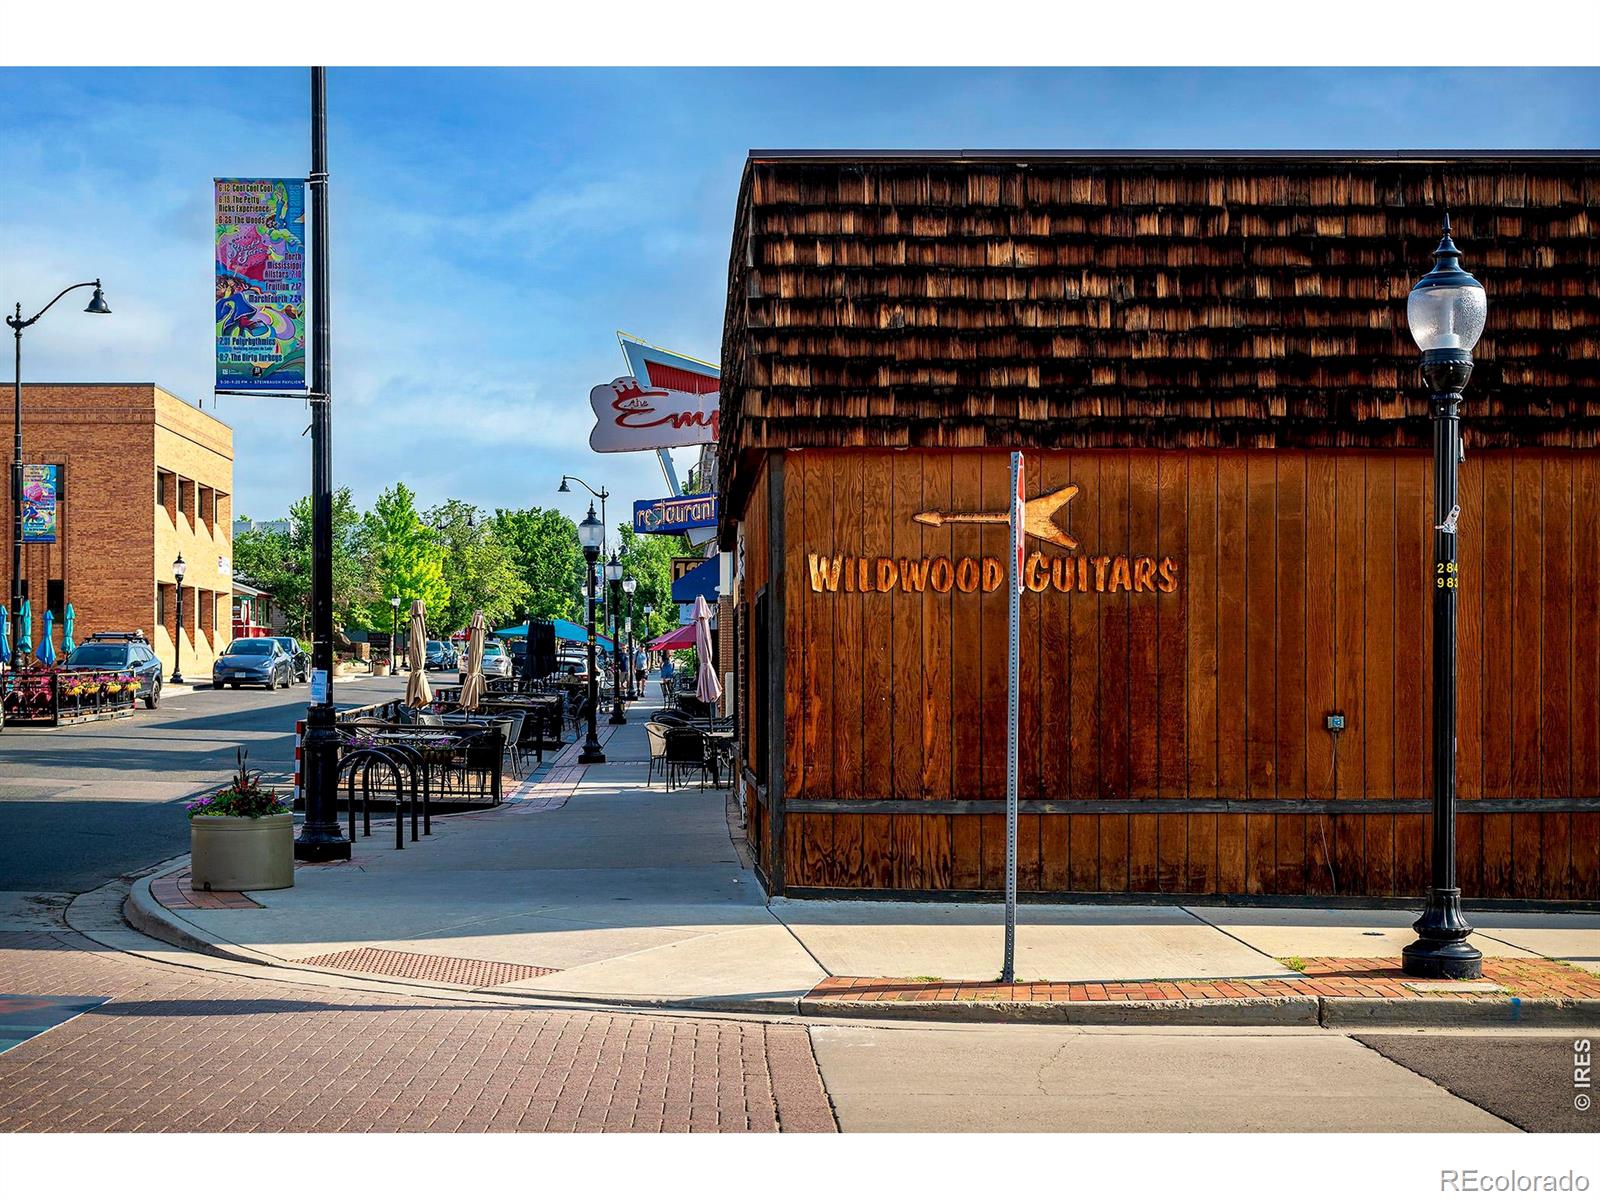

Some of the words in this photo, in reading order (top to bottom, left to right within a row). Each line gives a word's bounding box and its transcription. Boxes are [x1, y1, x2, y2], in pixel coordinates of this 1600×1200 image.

[232, 184, 245, 192] Cool
[246, 184, 259, 192] Cool
[260, 184, 273, 192] Cool
[232, 195, 243, 204] The
[244, 195, 260, 206] Petty
[236, 204, 270, 214] Experience
[234, 215, 245, 224] The
[245, 215, 265, 224] Woods
[284, 252, 302, 261] North
[267, 261, 302, 271] Mississippi
[264, 270, 289, 279] Allstars
[265, 282, 289, 291] Fruition
[231, 353, 242, 361] The
[242, 353, 258, 363] Dirty
[258, 353, 283, 363] Turkeys
[637, 495, 718, 527] restaurant
[1024, 550, 1179, 594] GUITARS
